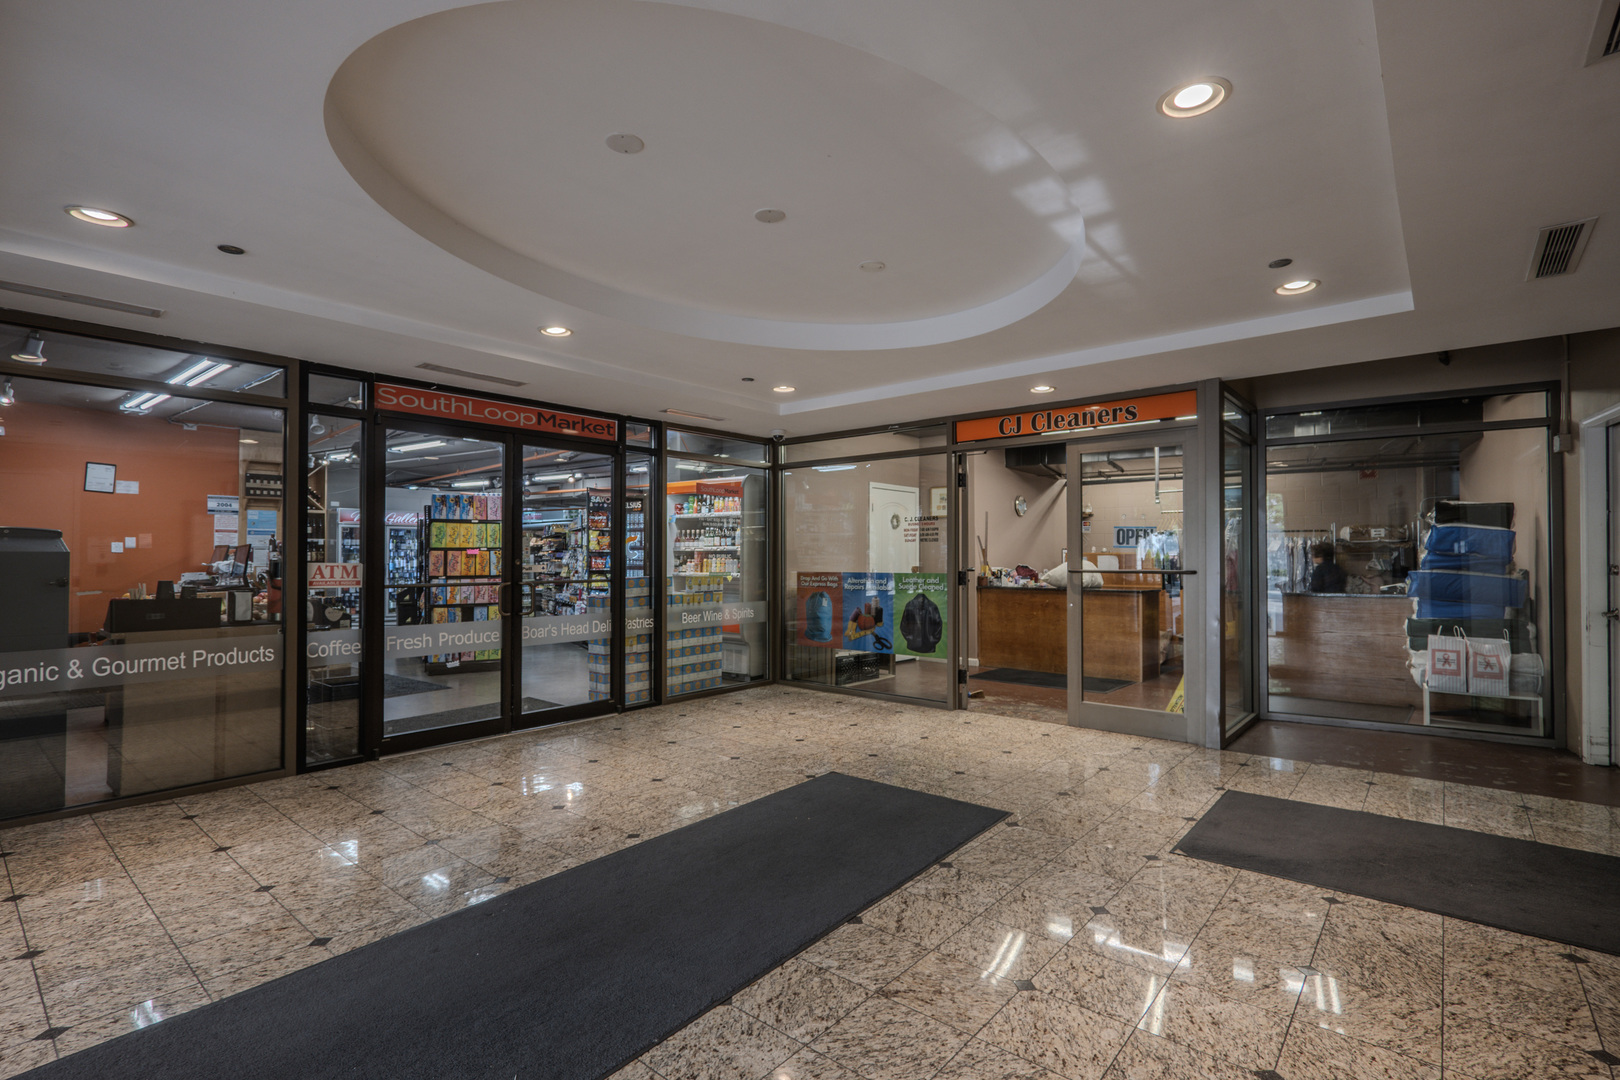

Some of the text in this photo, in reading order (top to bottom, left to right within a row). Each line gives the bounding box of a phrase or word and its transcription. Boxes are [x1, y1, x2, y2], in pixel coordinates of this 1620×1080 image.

[377, 387, 614, 436] SouthLoopMarket
[998, 405, 1138, 436] CJ Cleaners
[311, 564, 359, 580] ATM
[902, 577, 925, 585] Leather
[898, 584, 945, 592] Suede Cleaned
[681, 607, 755, 624] Beer Wine & Spirits
[521, 619, 611, 640] Boar's Head Deli
[307, 640, 361, 658] Coffee
[386, 629, 500, 651] Fresh Produce
[66, 658, 84, 679] &
[92, 651, 187, 677] Gourmet
[192, 645, 276, 668] Products
